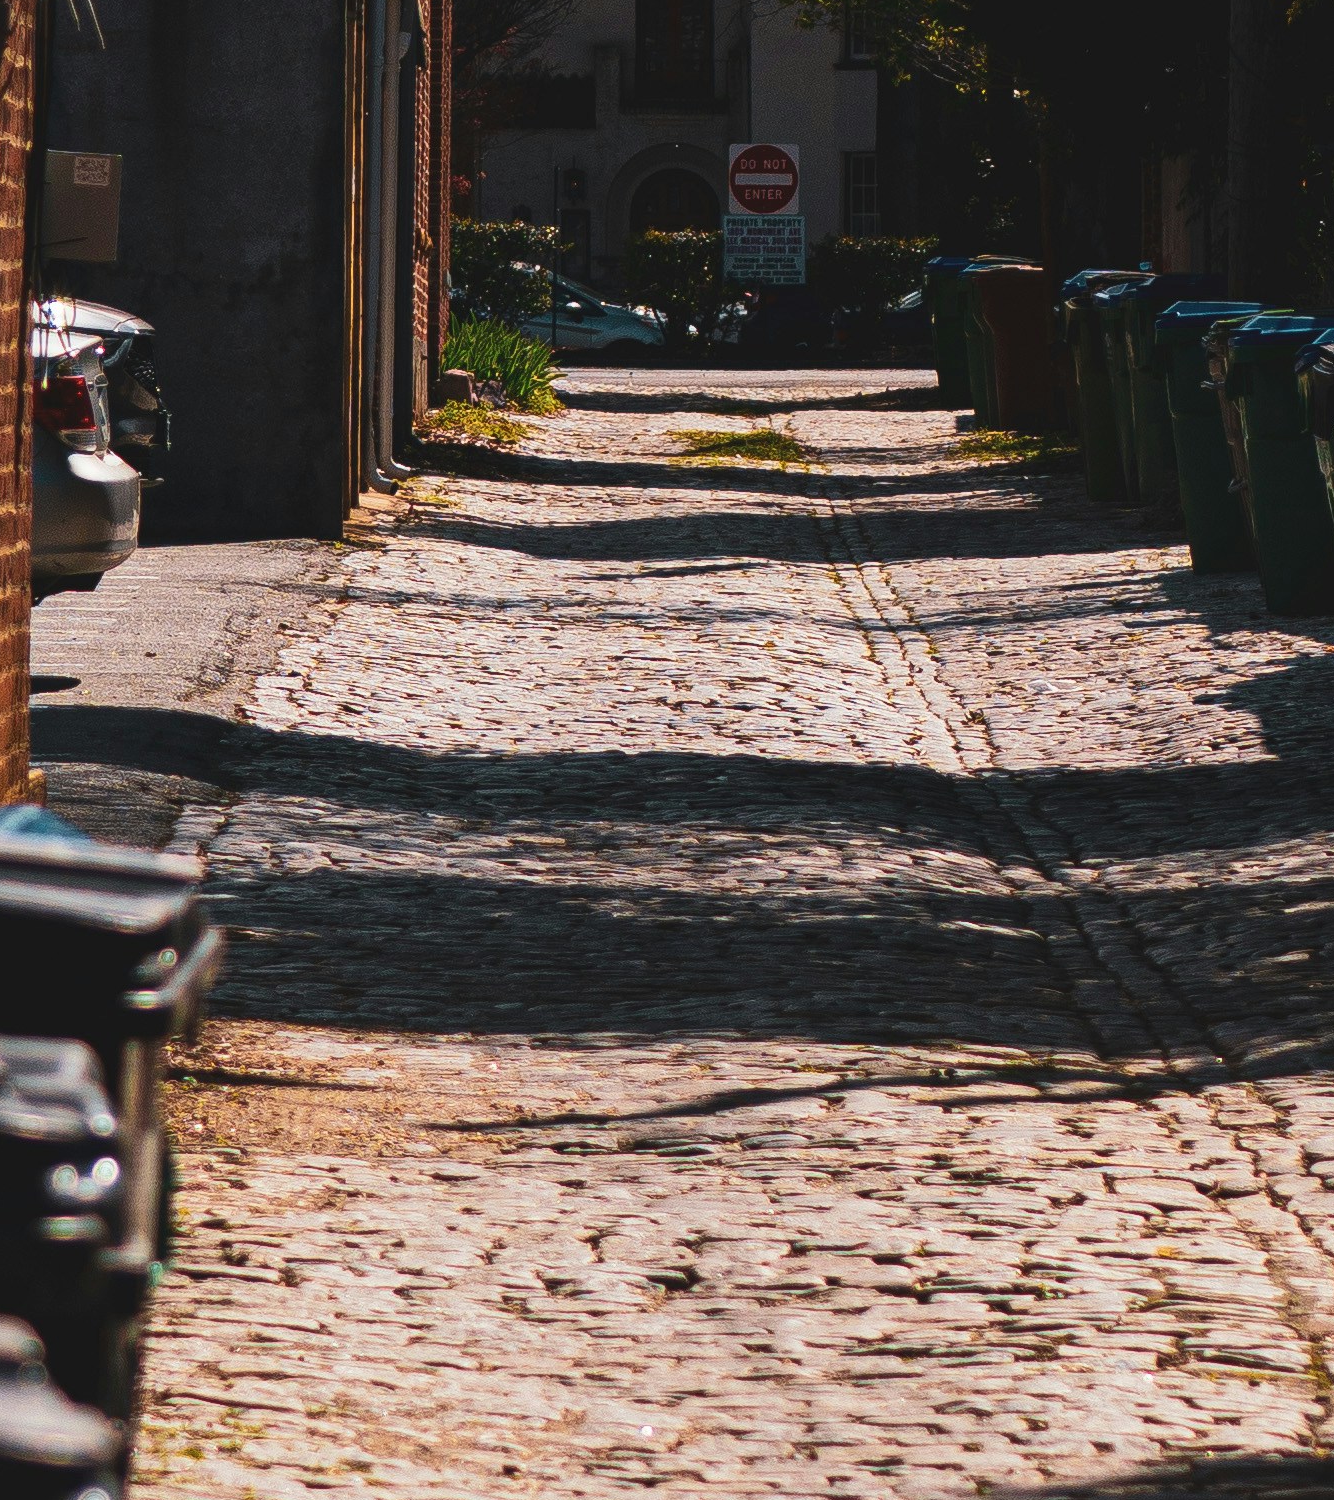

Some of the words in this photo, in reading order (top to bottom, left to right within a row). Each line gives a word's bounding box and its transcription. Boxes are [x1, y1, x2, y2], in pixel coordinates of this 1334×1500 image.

[740, 159, 756, 170] DO
[763, 159, 787, 170] NOT
[745, 189, 783, 200] ENTER
[726, 218, 759, 227] PRIVATE
[761, 218, 802, 227] PROPERTY
[747, 227, 785, 236] MONUMENT
[789, 227, 801, 236] AVE
[741, 236, 769, 245] MEDICAL
